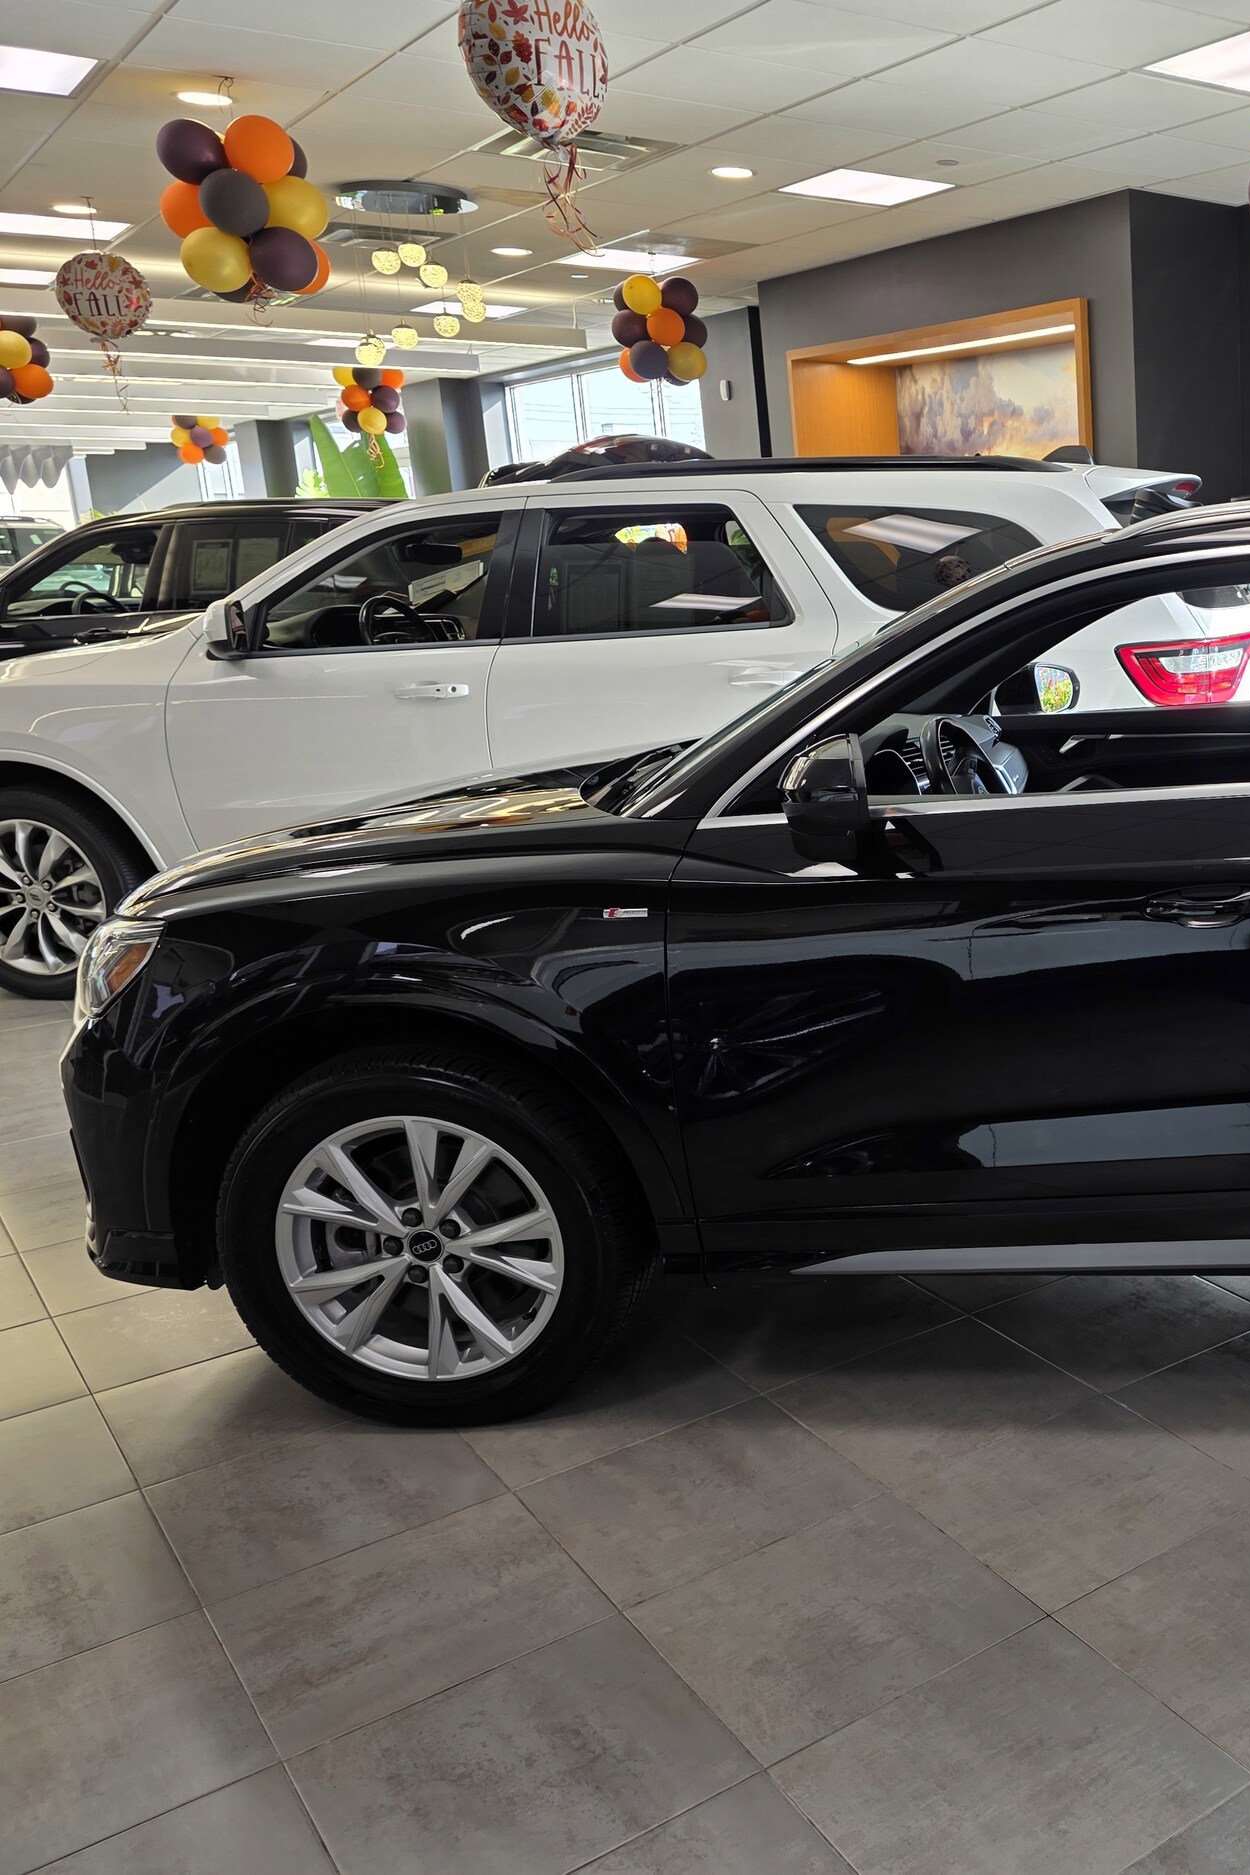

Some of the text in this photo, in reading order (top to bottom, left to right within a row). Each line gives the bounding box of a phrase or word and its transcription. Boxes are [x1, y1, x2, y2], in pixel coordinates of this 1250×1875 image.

[534, 0, 595, 42] Hello
[534, 38, 599, 99] FALL
[73, 268, 121, 290] Hello
[73, 291, 127, 317] FALL
